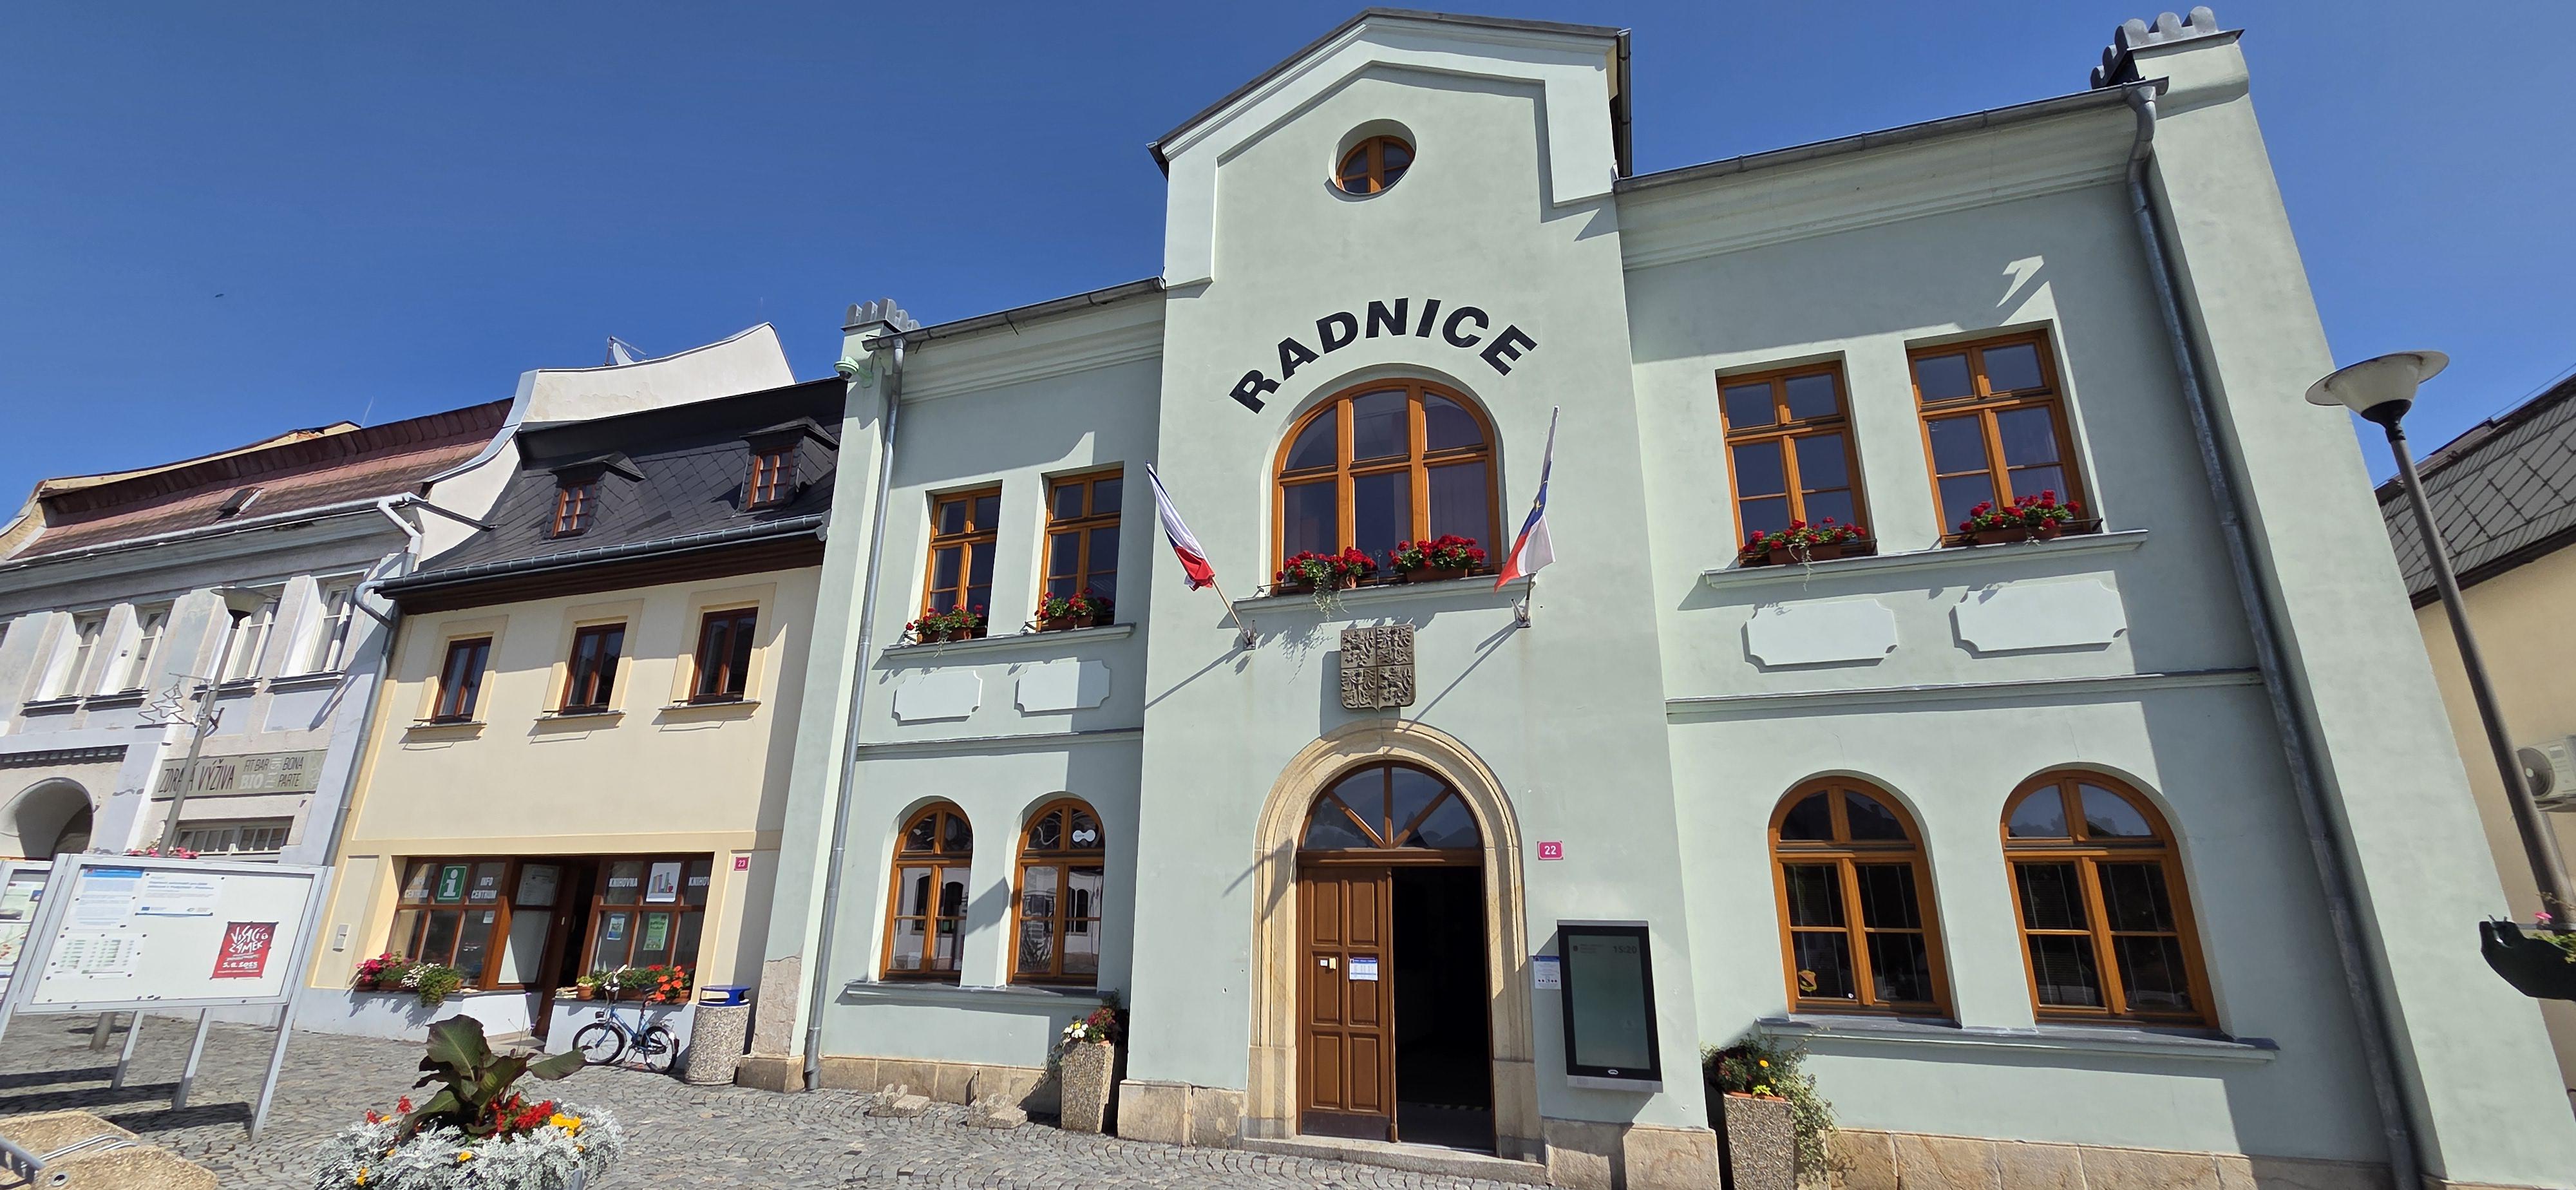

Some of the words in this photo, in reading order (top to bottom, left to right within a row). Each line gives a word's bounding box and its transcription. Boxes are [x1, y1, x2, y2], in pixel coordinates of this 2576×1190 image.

[1229, 298, 1537, 414] RADNICE
[254, 759, 269, 771] BAR
[282, 756, 304, 771] BONA
[158, 761, 200, 793] ZDRAÁ
[198, 759, 235, 791] VÝŽIVA
[239, 773, 264, 789] BIO
[278, 773, 301, 787] PARTE
[1544, 845, 1557, 855] 22
[609, 878, 638, 887] KNIHOVNA
[1613, 945, 1638, 954] 15:20
